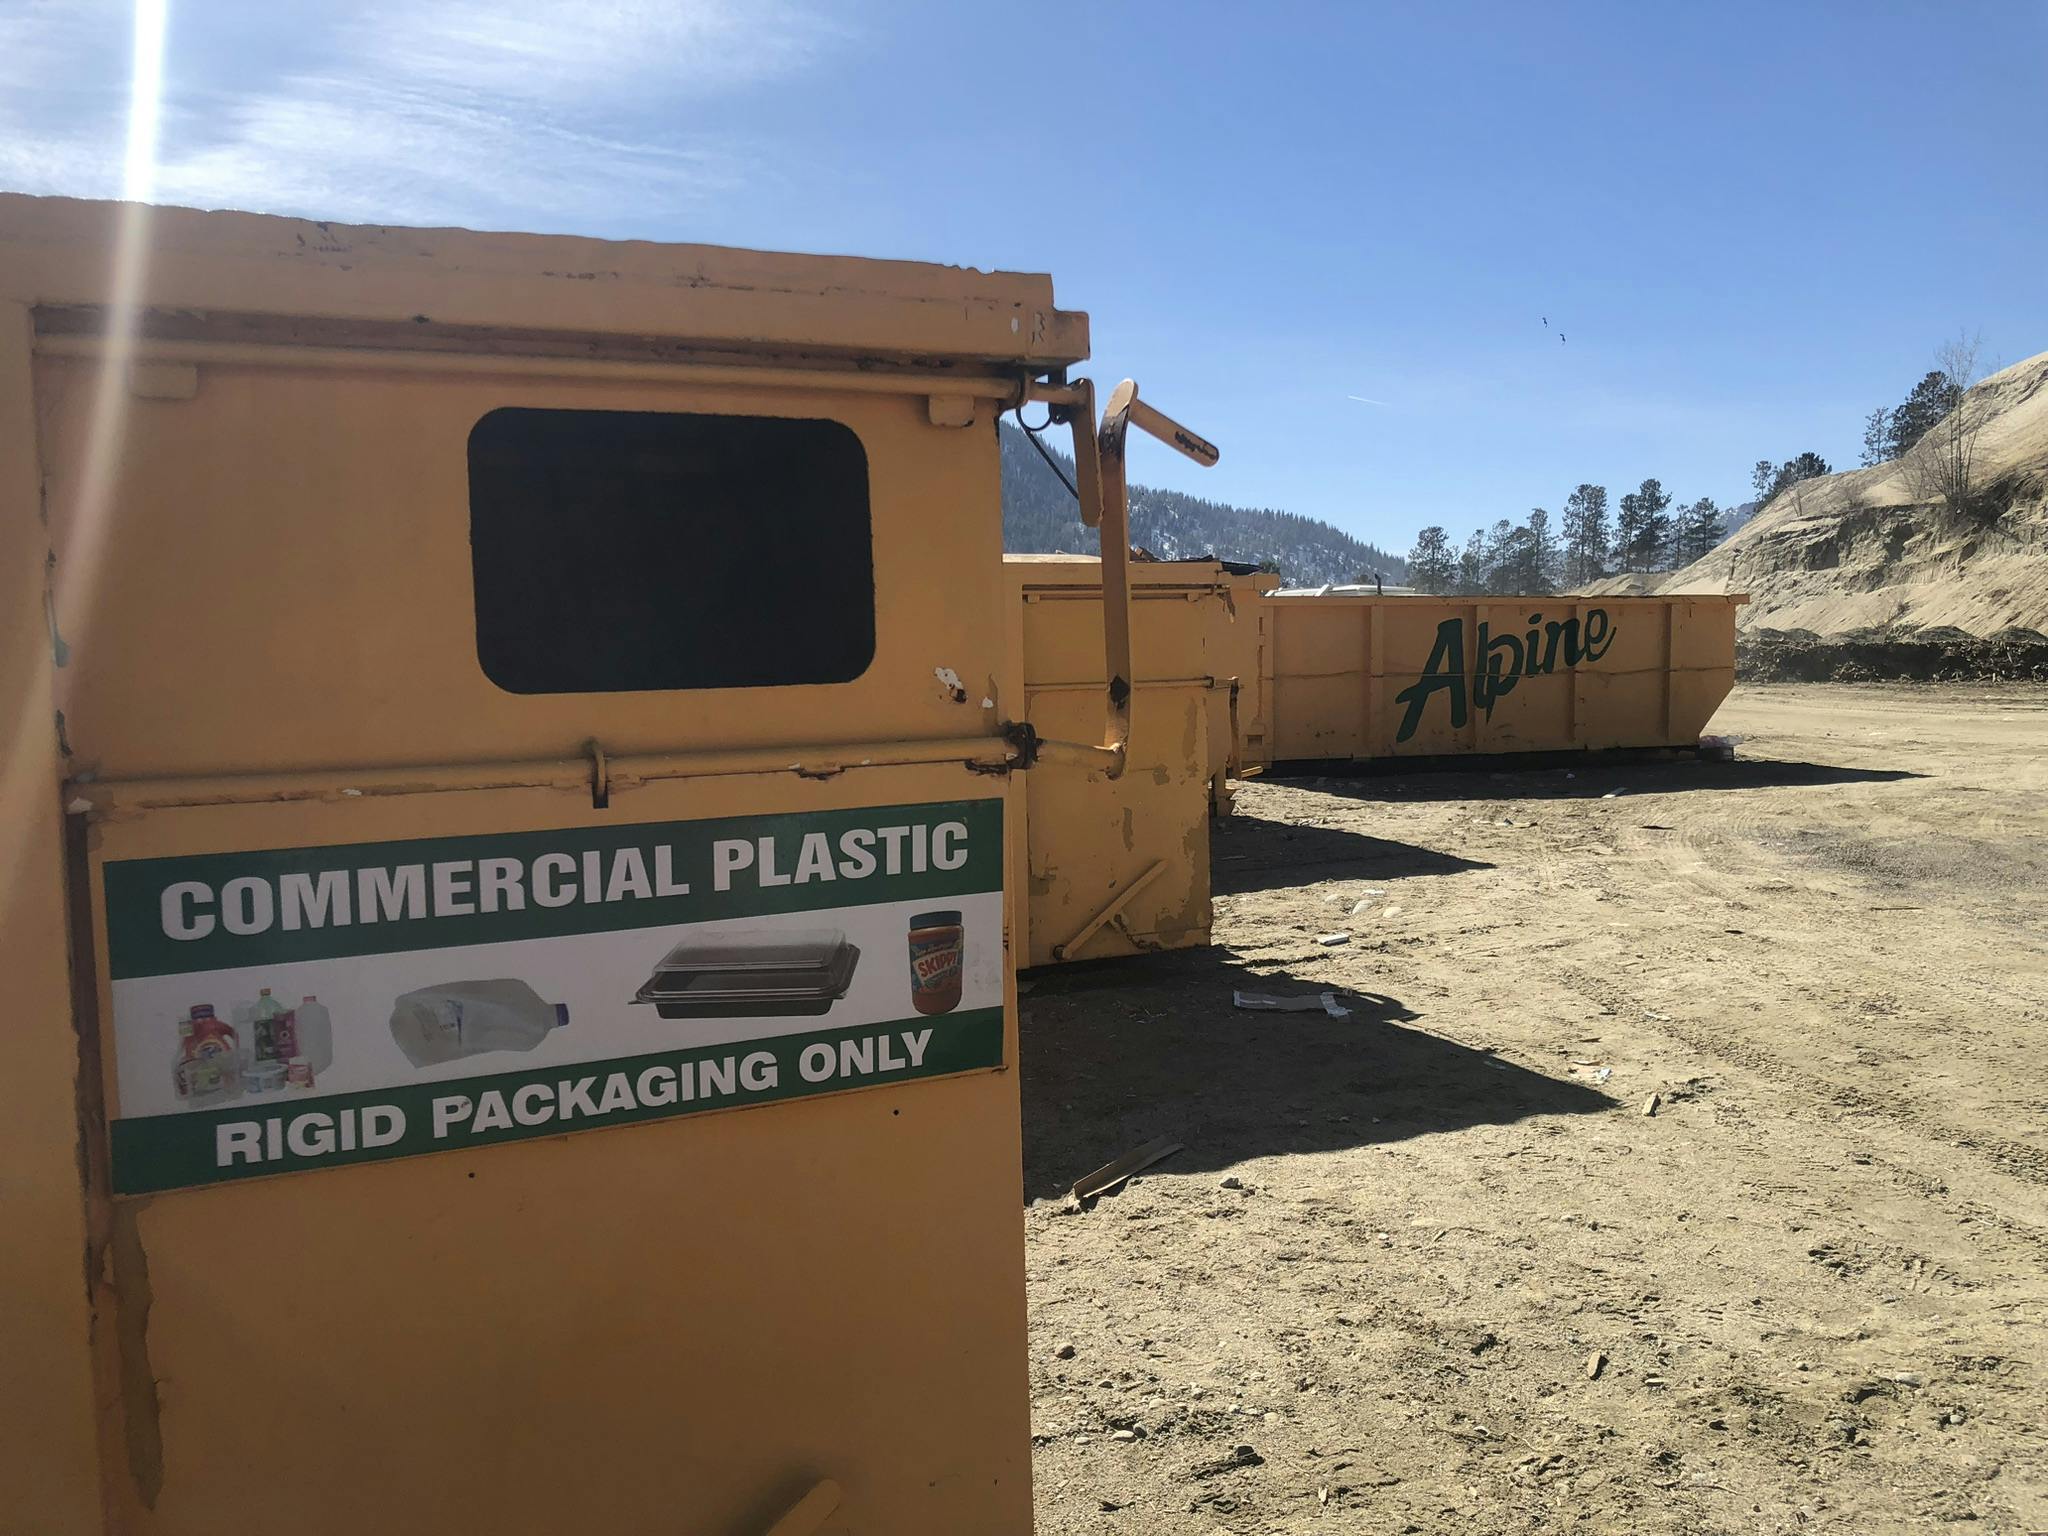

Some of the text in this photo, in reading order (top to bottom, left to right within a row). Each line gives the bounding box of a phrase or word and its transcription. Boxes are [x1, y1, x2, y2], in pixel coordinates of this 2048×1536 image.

[1395, 608, 1617, 744] Alpine
[161, 821, 968, 941] COMMERCIAL PLASTIC
[216, 1029, 934, 1167] RIGID PACKAGING ONLY
